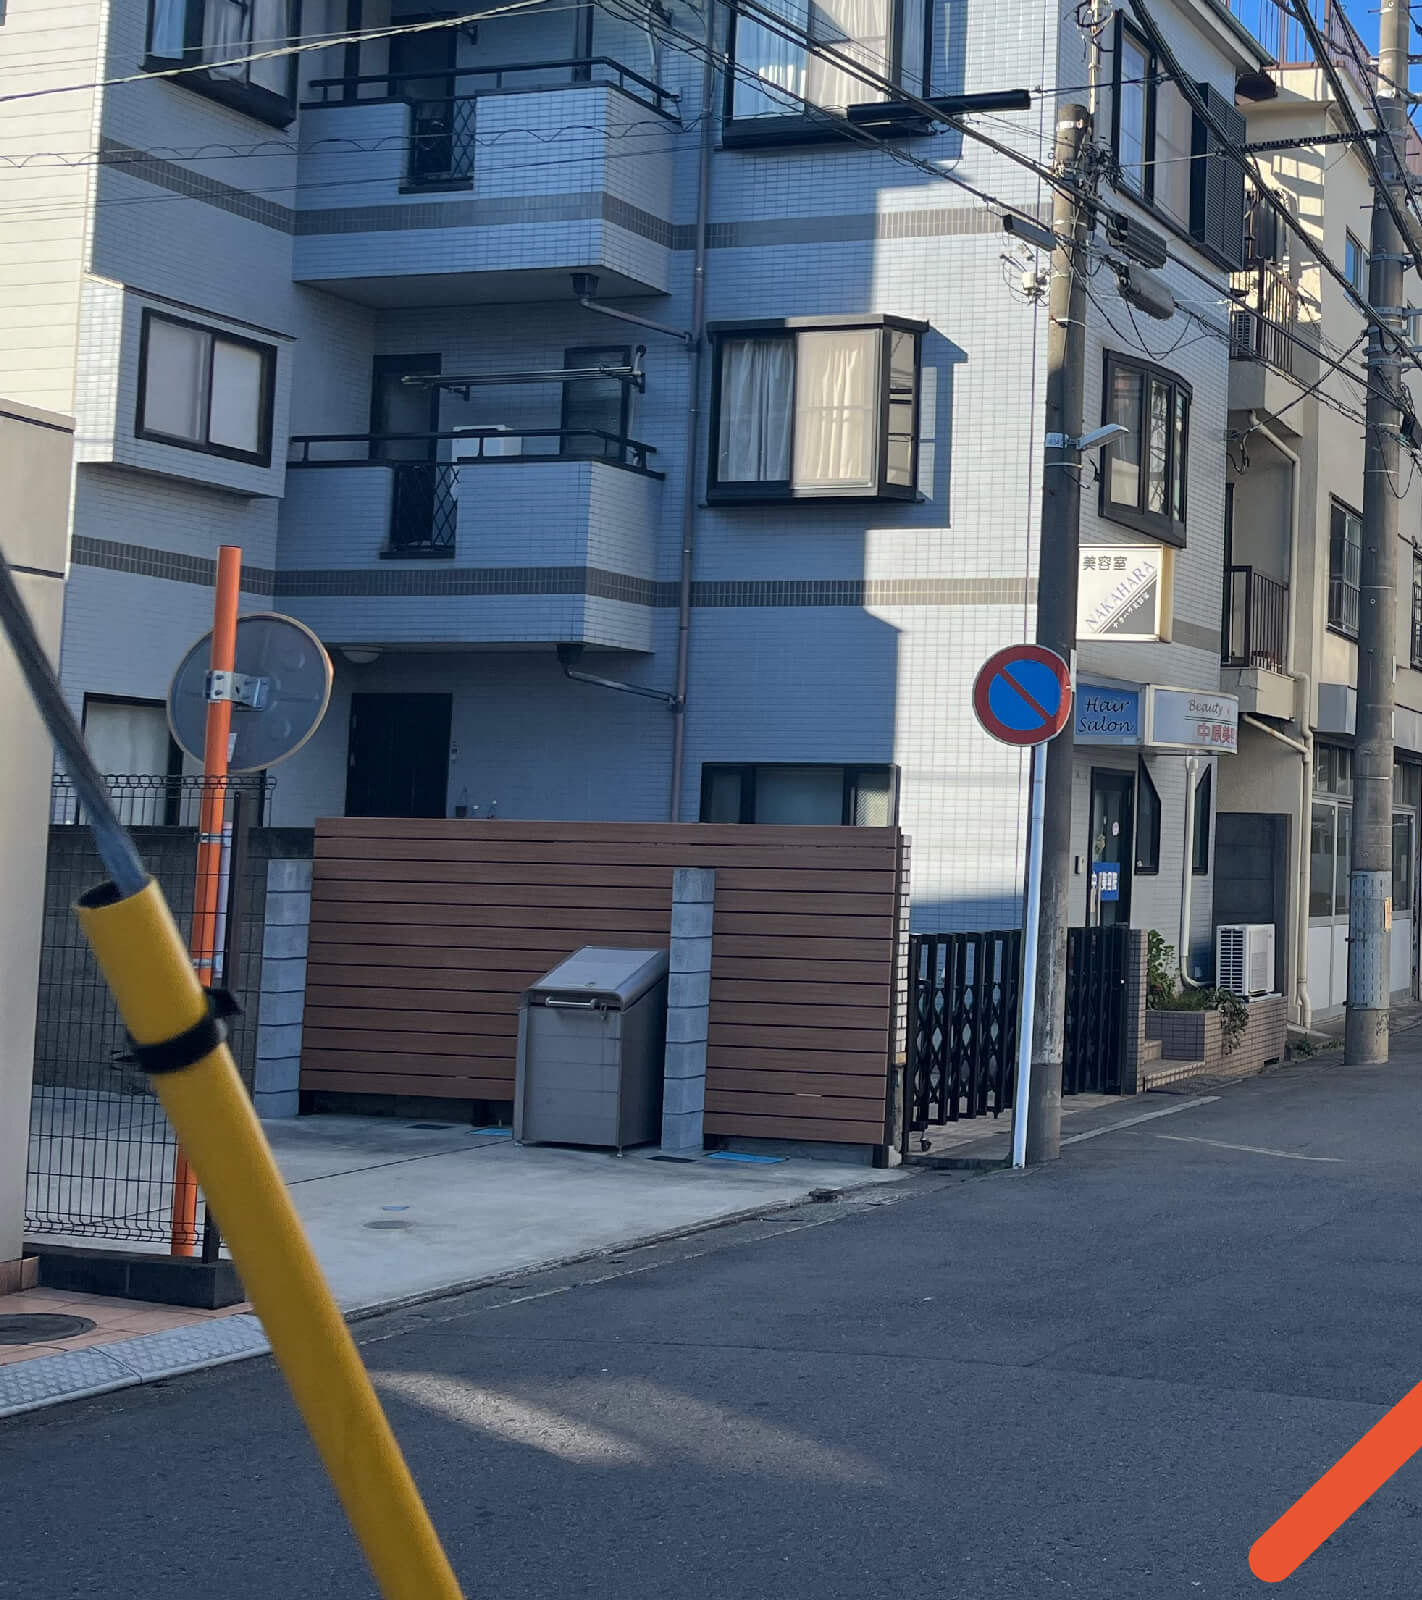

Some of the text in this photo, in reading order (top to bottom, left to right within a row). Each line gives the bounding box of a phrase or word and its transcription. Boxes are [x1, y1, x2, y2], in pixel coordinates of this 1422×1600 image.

[1082, 555, 1128, 571] 美容室
[1085, 561, 1156, 631] NAKAHARA
[1086, 697, 1130, 713] Hair
[1188, 696, 1224, 717] Beauty
[1078, 716, 1134, 733] Salon
